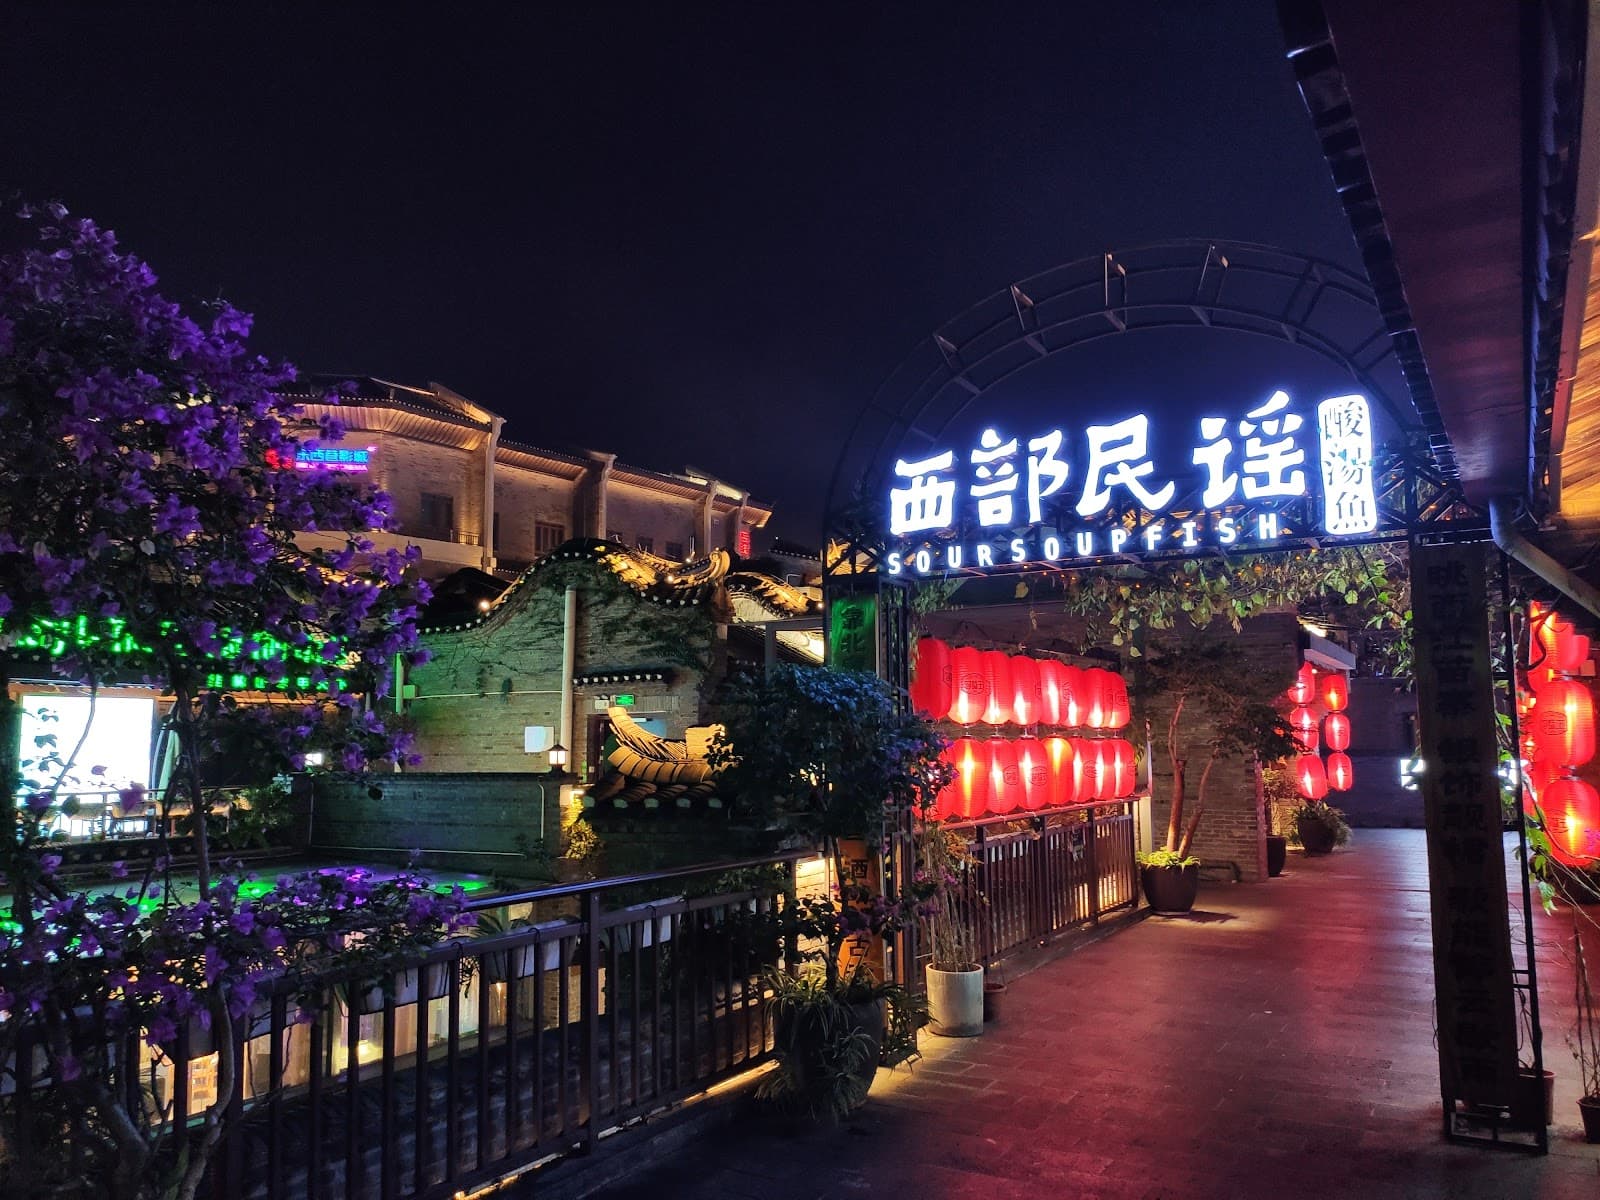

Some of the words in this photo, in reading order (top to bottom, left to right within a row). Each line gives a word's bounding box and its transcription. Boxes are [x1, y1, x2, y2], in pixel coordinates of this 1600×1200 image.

[889, 390, 1306, 535] 西部民谣
[887, 512, 1280, 576] SOURSOUPFISH
